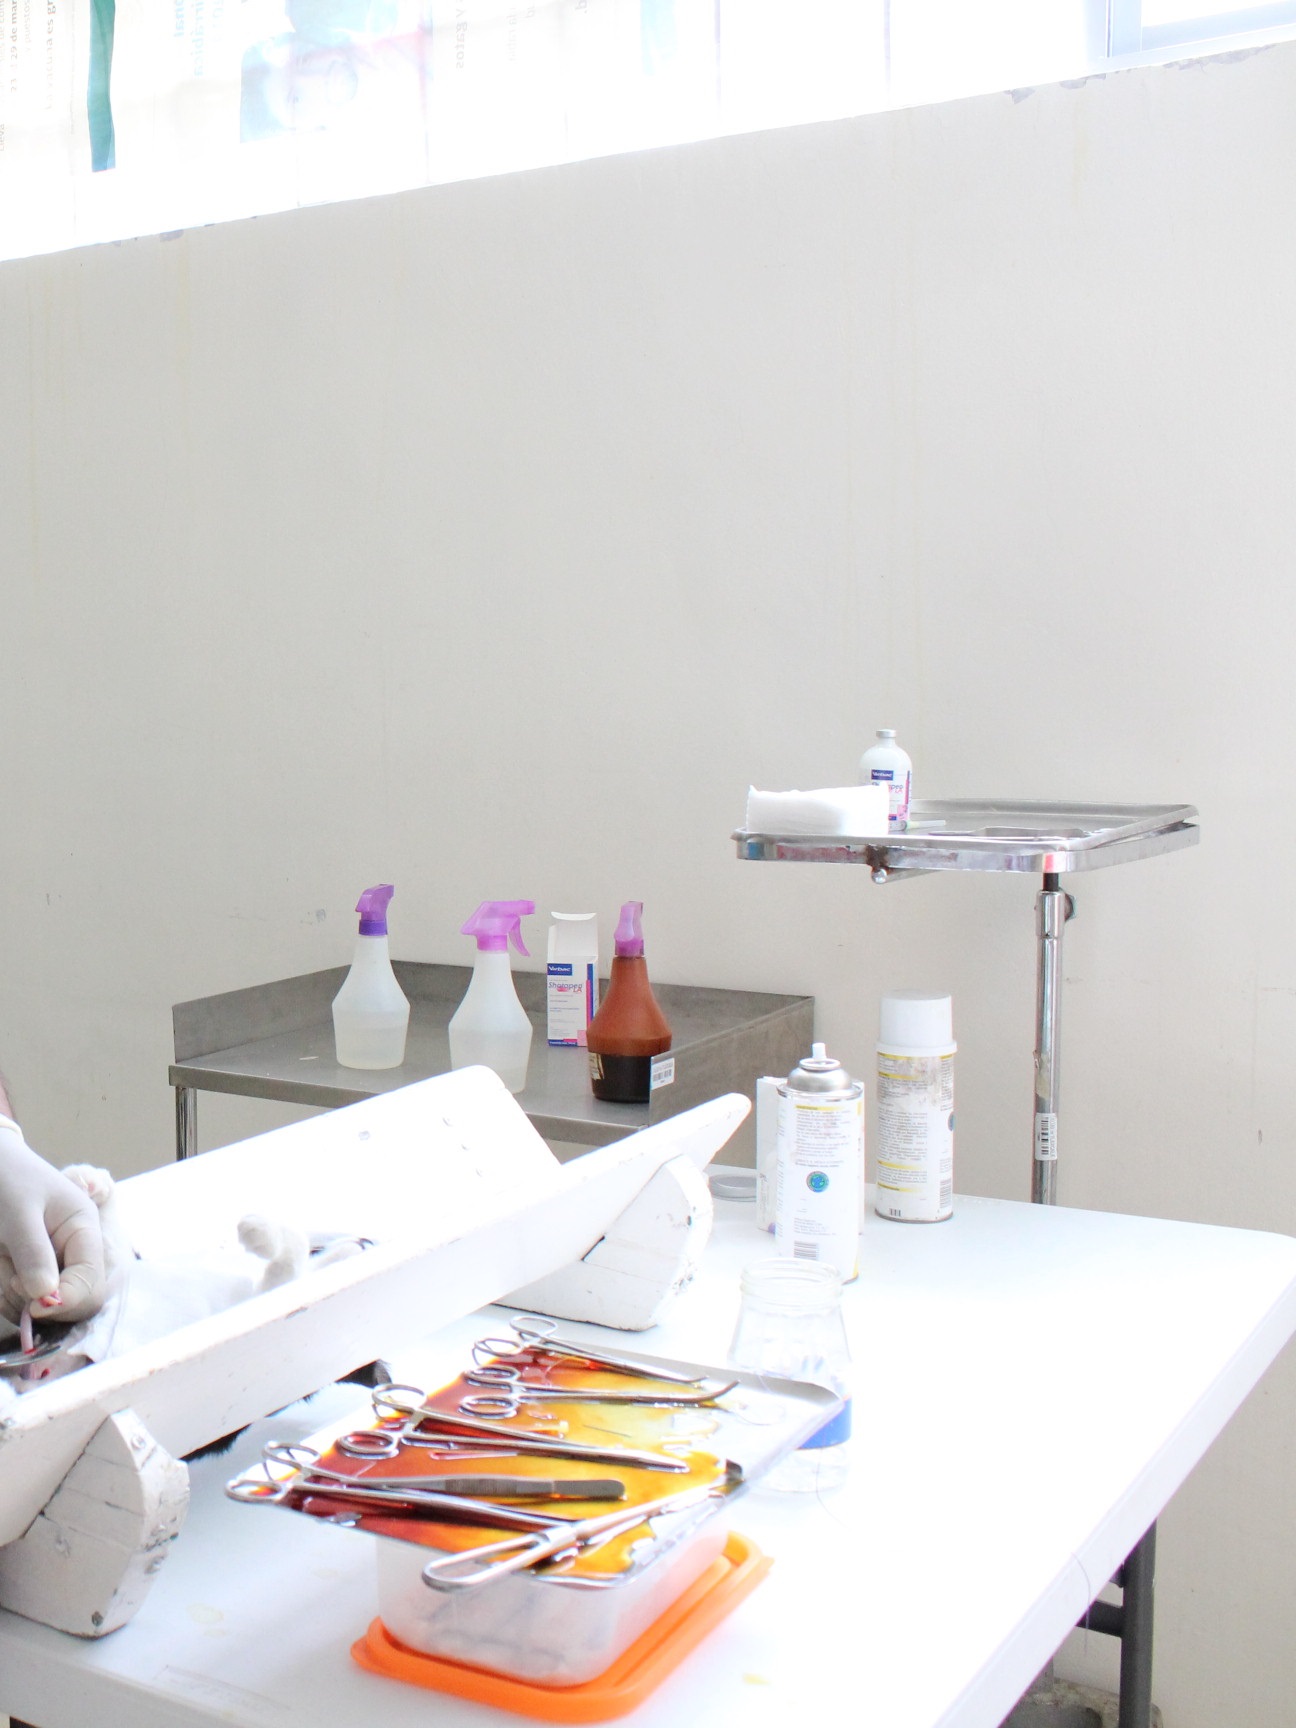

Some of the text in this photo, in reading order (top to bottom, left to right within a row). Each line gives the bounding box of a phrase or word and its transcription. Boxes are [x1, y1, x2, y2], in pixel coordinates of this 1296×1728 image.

[46, 18, 54, 35] es
[9, 28, 17, 43] de
[10, 45, 18, 60] 29
